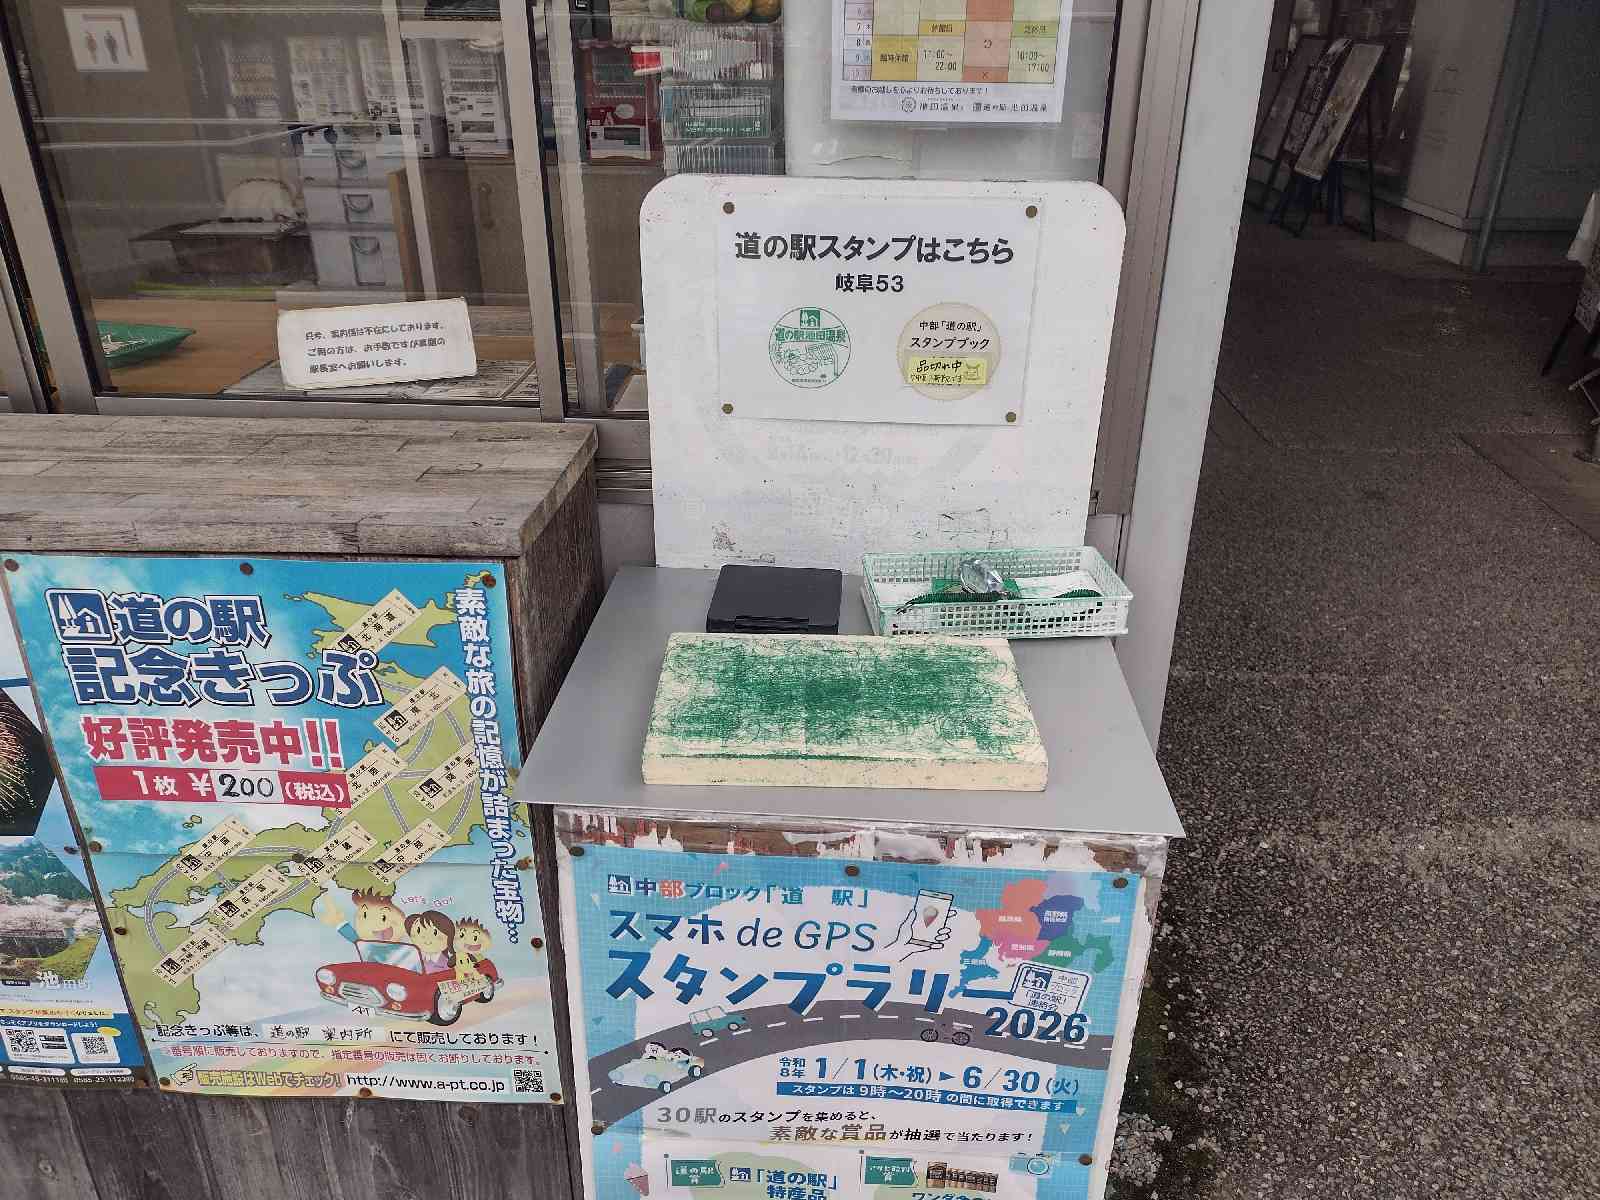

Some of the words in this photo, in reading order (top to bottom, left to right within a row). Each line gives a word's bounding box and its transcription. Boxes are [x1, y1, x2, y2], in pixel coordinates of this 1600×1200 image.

[734, 231, 1014, 265] 道の駅スタンプはこちら
[835, 273, 905, 294] 岐阜53
[919, 320, 983, 332] 中部「道の駅」
[910, 337, 991, 350] スタンプブック
[916, 359, 963, 374] 品切れ中
[109, 592, 270, 648] 道の駅
[63, 647, 386, 710] 記念きっぷ
[81, 715, 345, 771] 好評発売中!!
[609, 910, 726, 945] スマホ
[736, 917, 783, 948] de
[794, 920, 878, 952] GPS
[606, 949, 1014, 1016] スタンプラリー
[984, 1006, 1088, 1043] 2026
[779, 1057, 806, 1068] 令和
[779, 1068, 806, 1079] 8年
[348, 1075, 505, 1094] http://www.a-pt.co.jp
[756, 1168, 838, 1191] 「道の駅」
